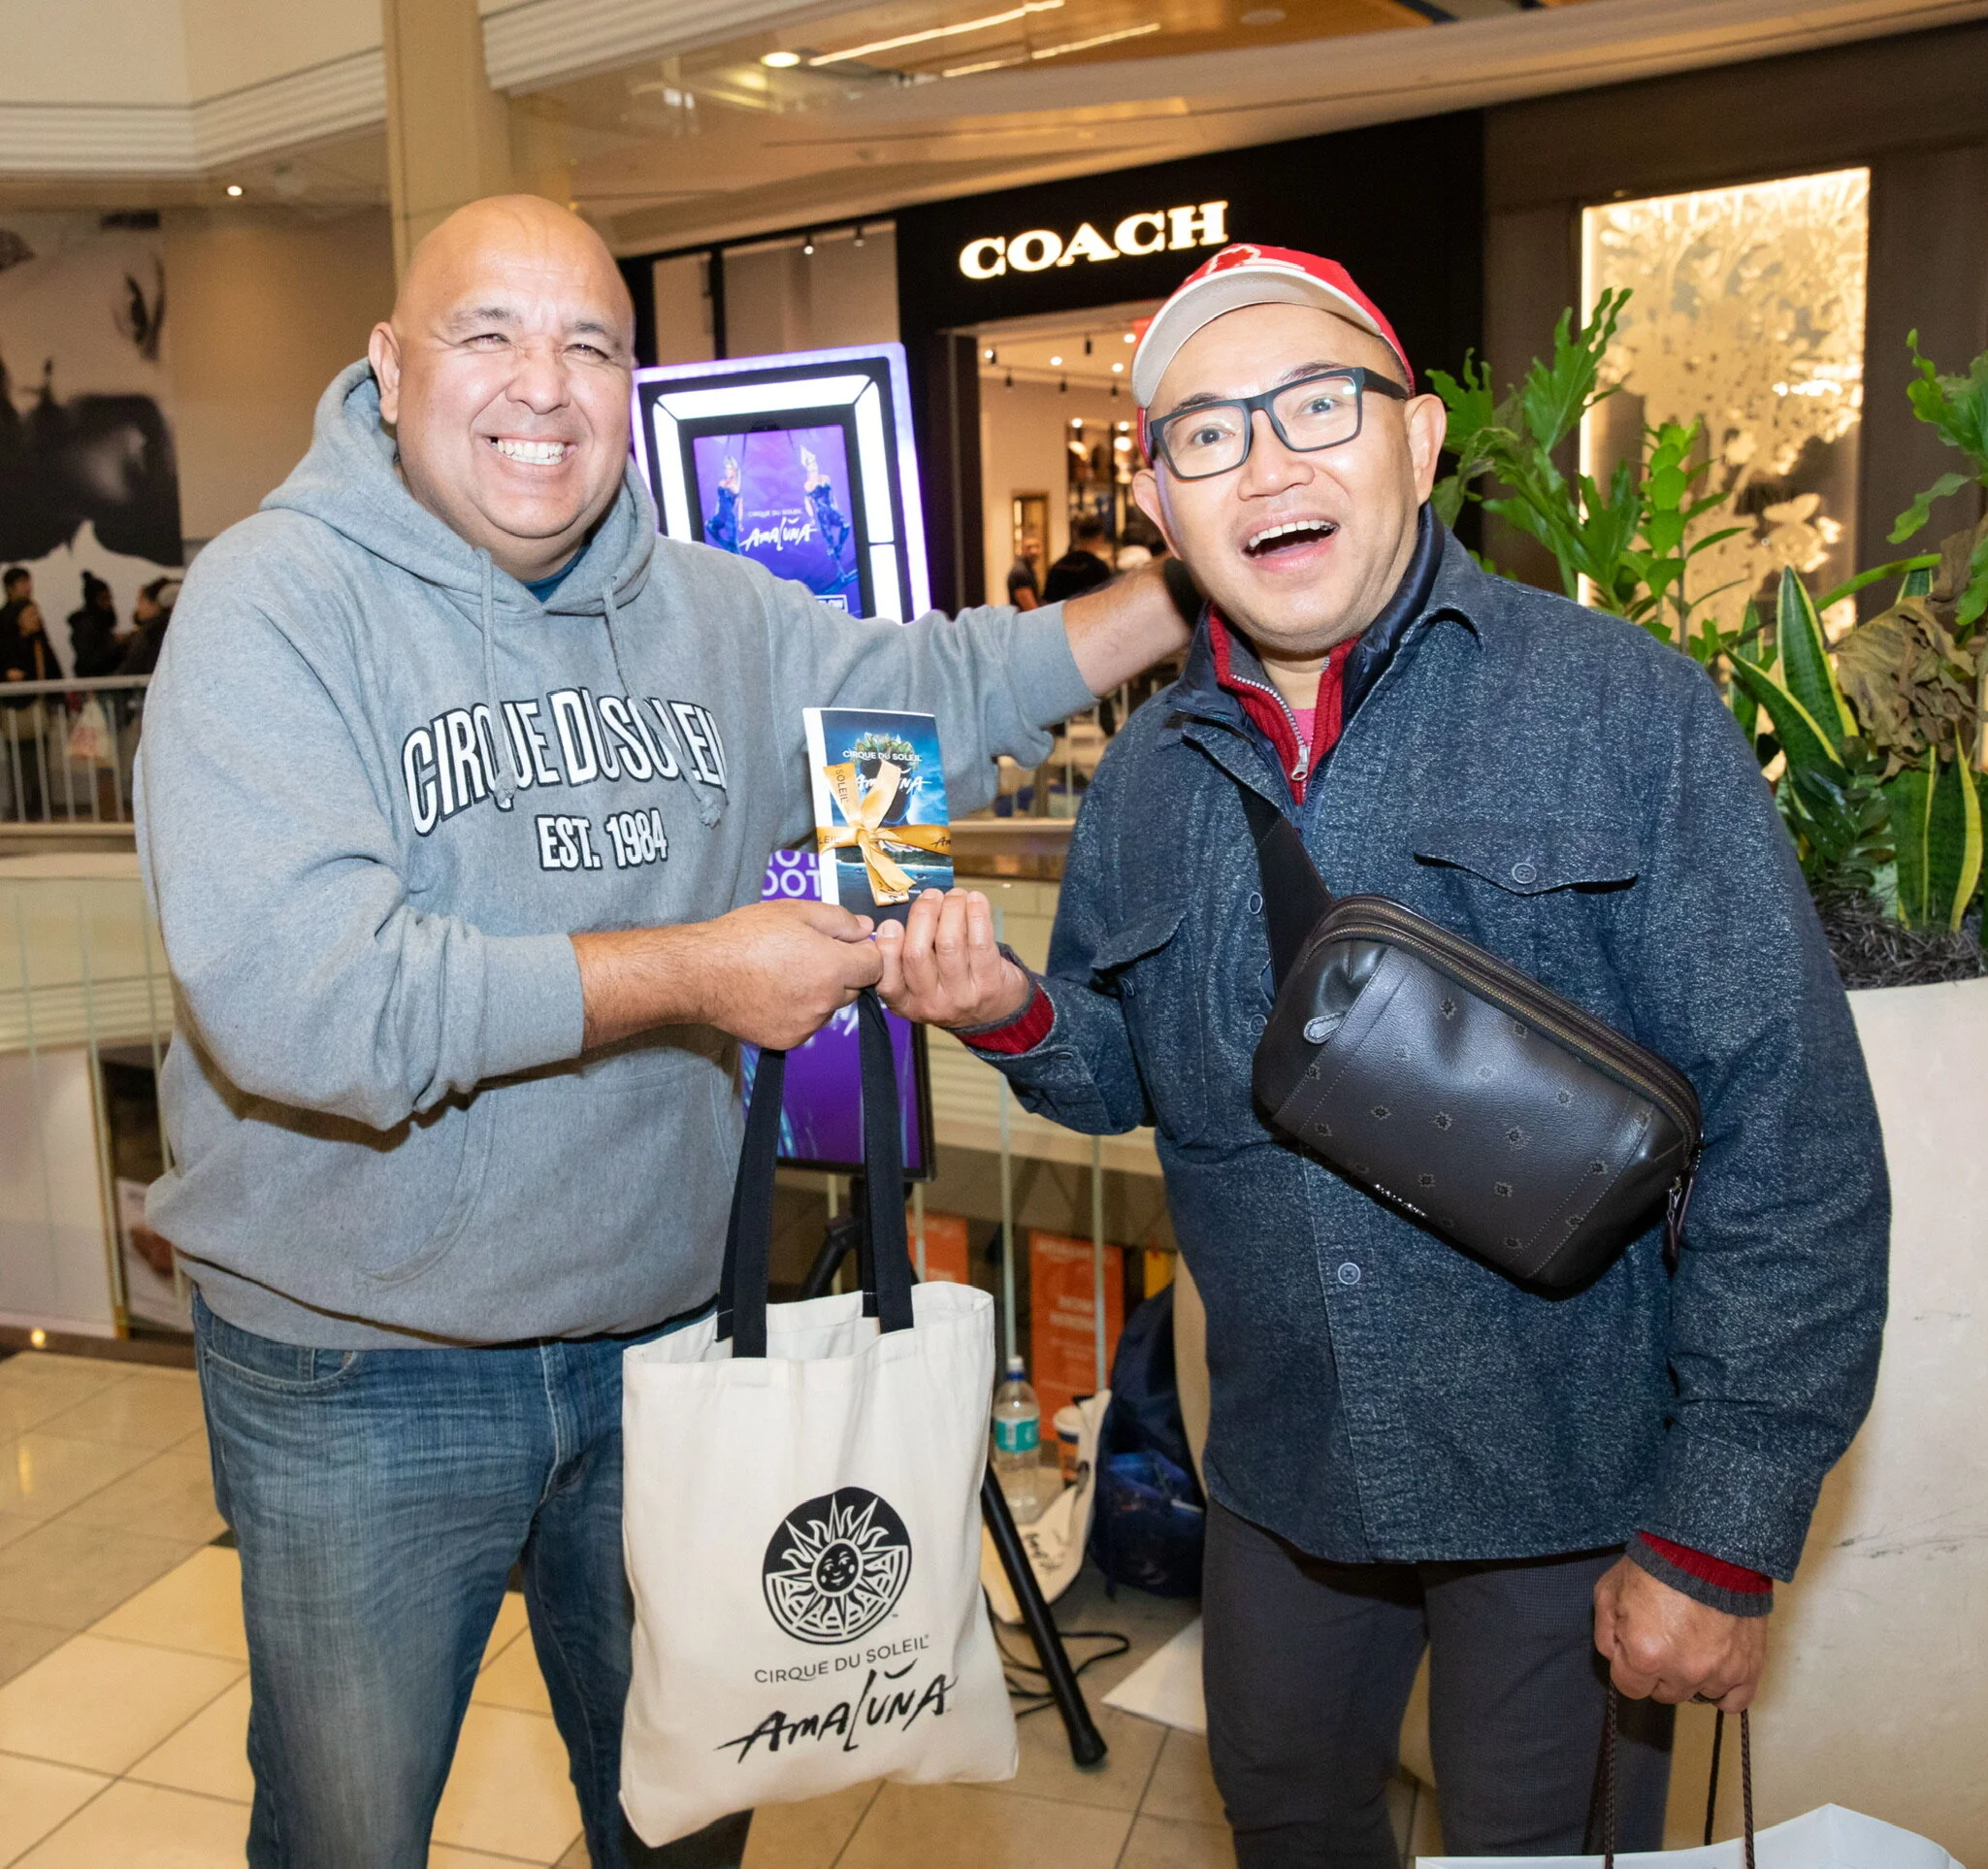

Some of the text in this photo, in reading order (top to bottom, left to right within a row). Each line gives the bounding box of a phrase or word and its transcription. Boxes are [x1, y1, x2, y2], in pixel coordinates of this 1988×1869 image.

[959, 200, 1229, 279] COACH
[401, 698, 563, 837] CIRQUE
[842, 750, 876, 761] CIRQUE
[892, 753, 923, 762] SOLEIL
[534, 807, 668, 870] EST. 1984
[754, 1634, 929, 1684] CIRQUE DU SOLEIL
